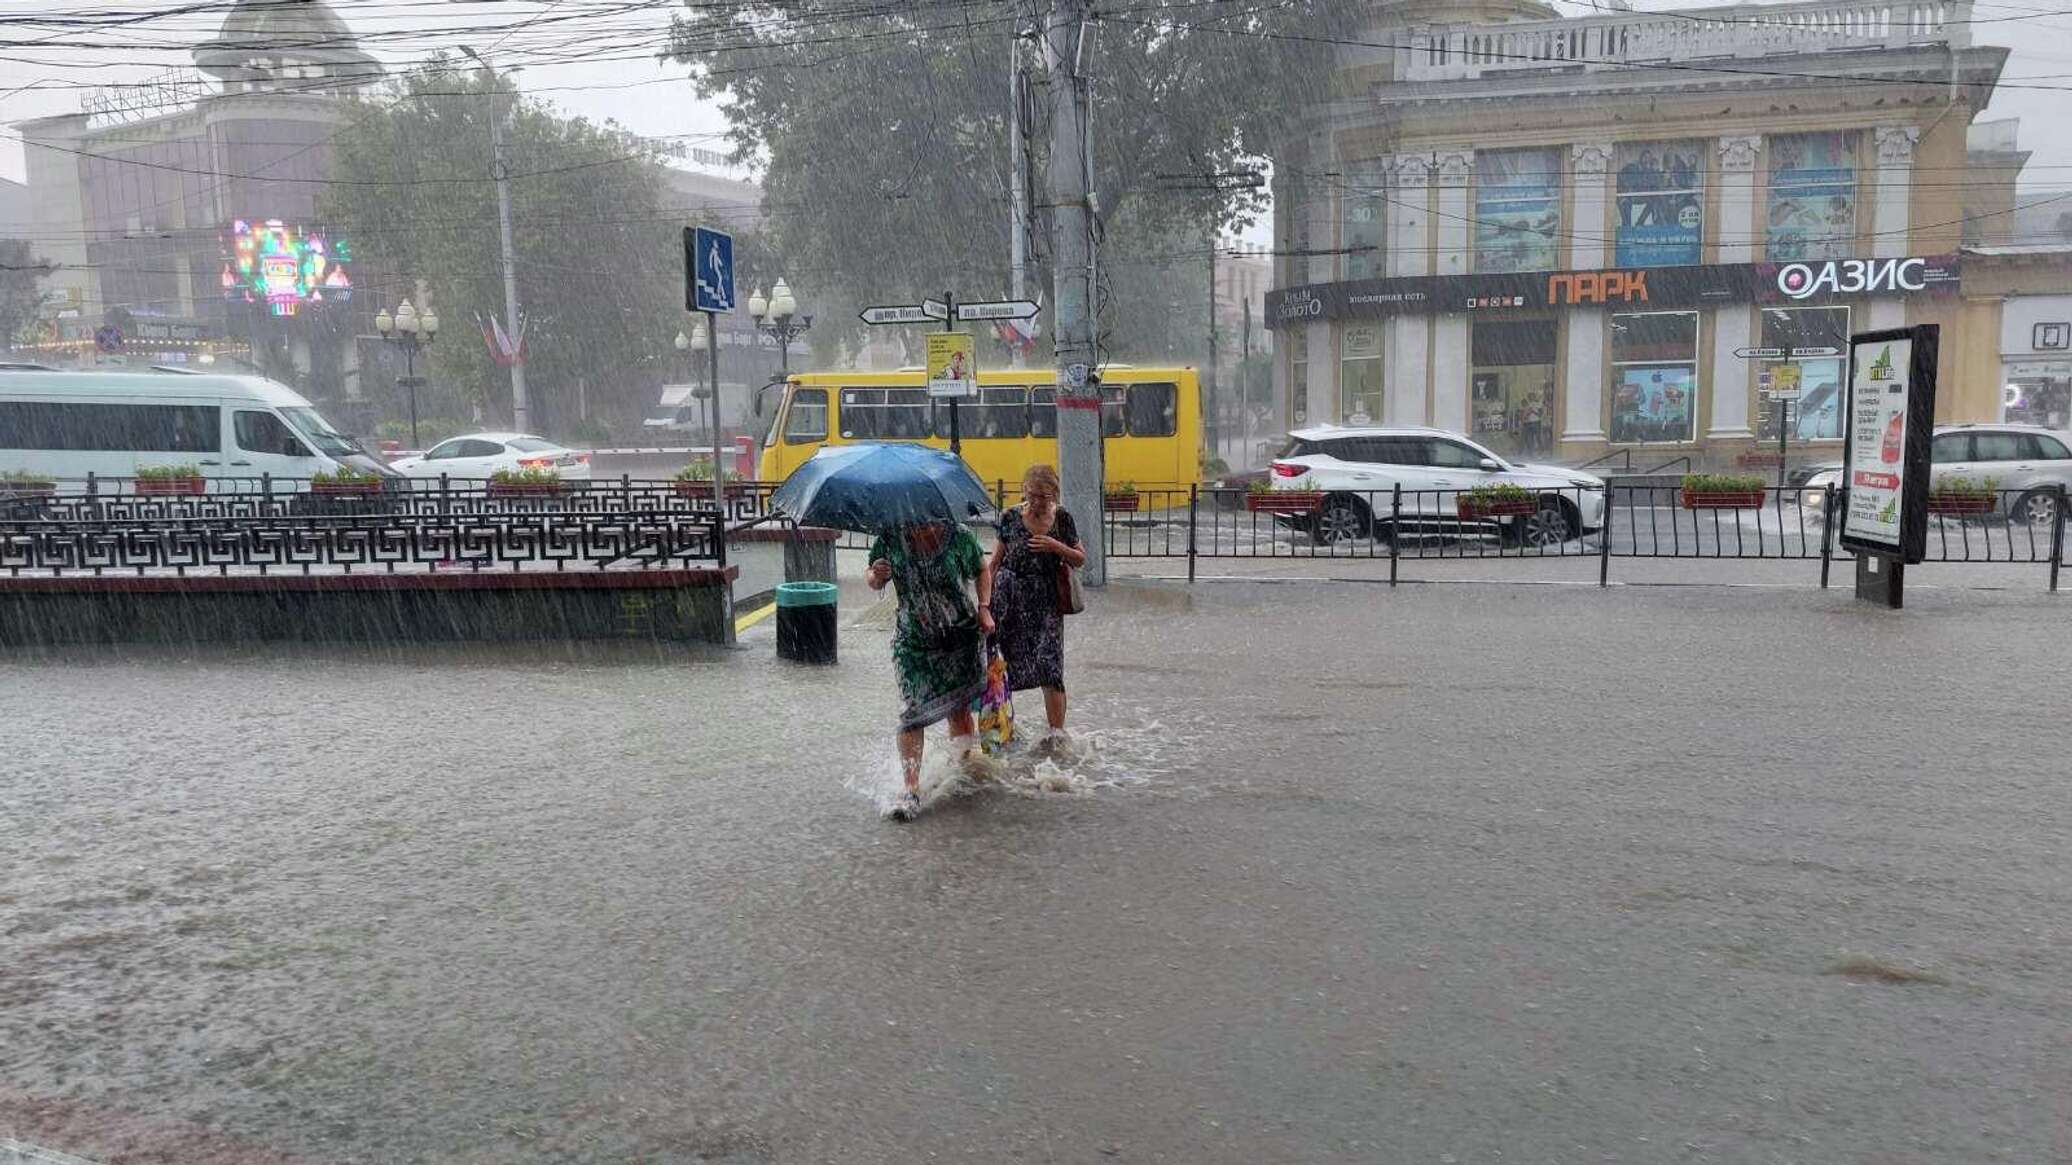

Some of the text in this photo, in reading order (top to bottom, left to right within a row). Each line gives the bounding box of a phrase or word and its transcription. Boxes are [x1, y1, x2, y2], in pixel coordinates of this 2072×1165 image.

[1548, 271, 1649, 305] ПАРК
[1777, 258, 1926, 300] ОАЗИС
[1349, 292, 1425, 304] ювелирная сеть
